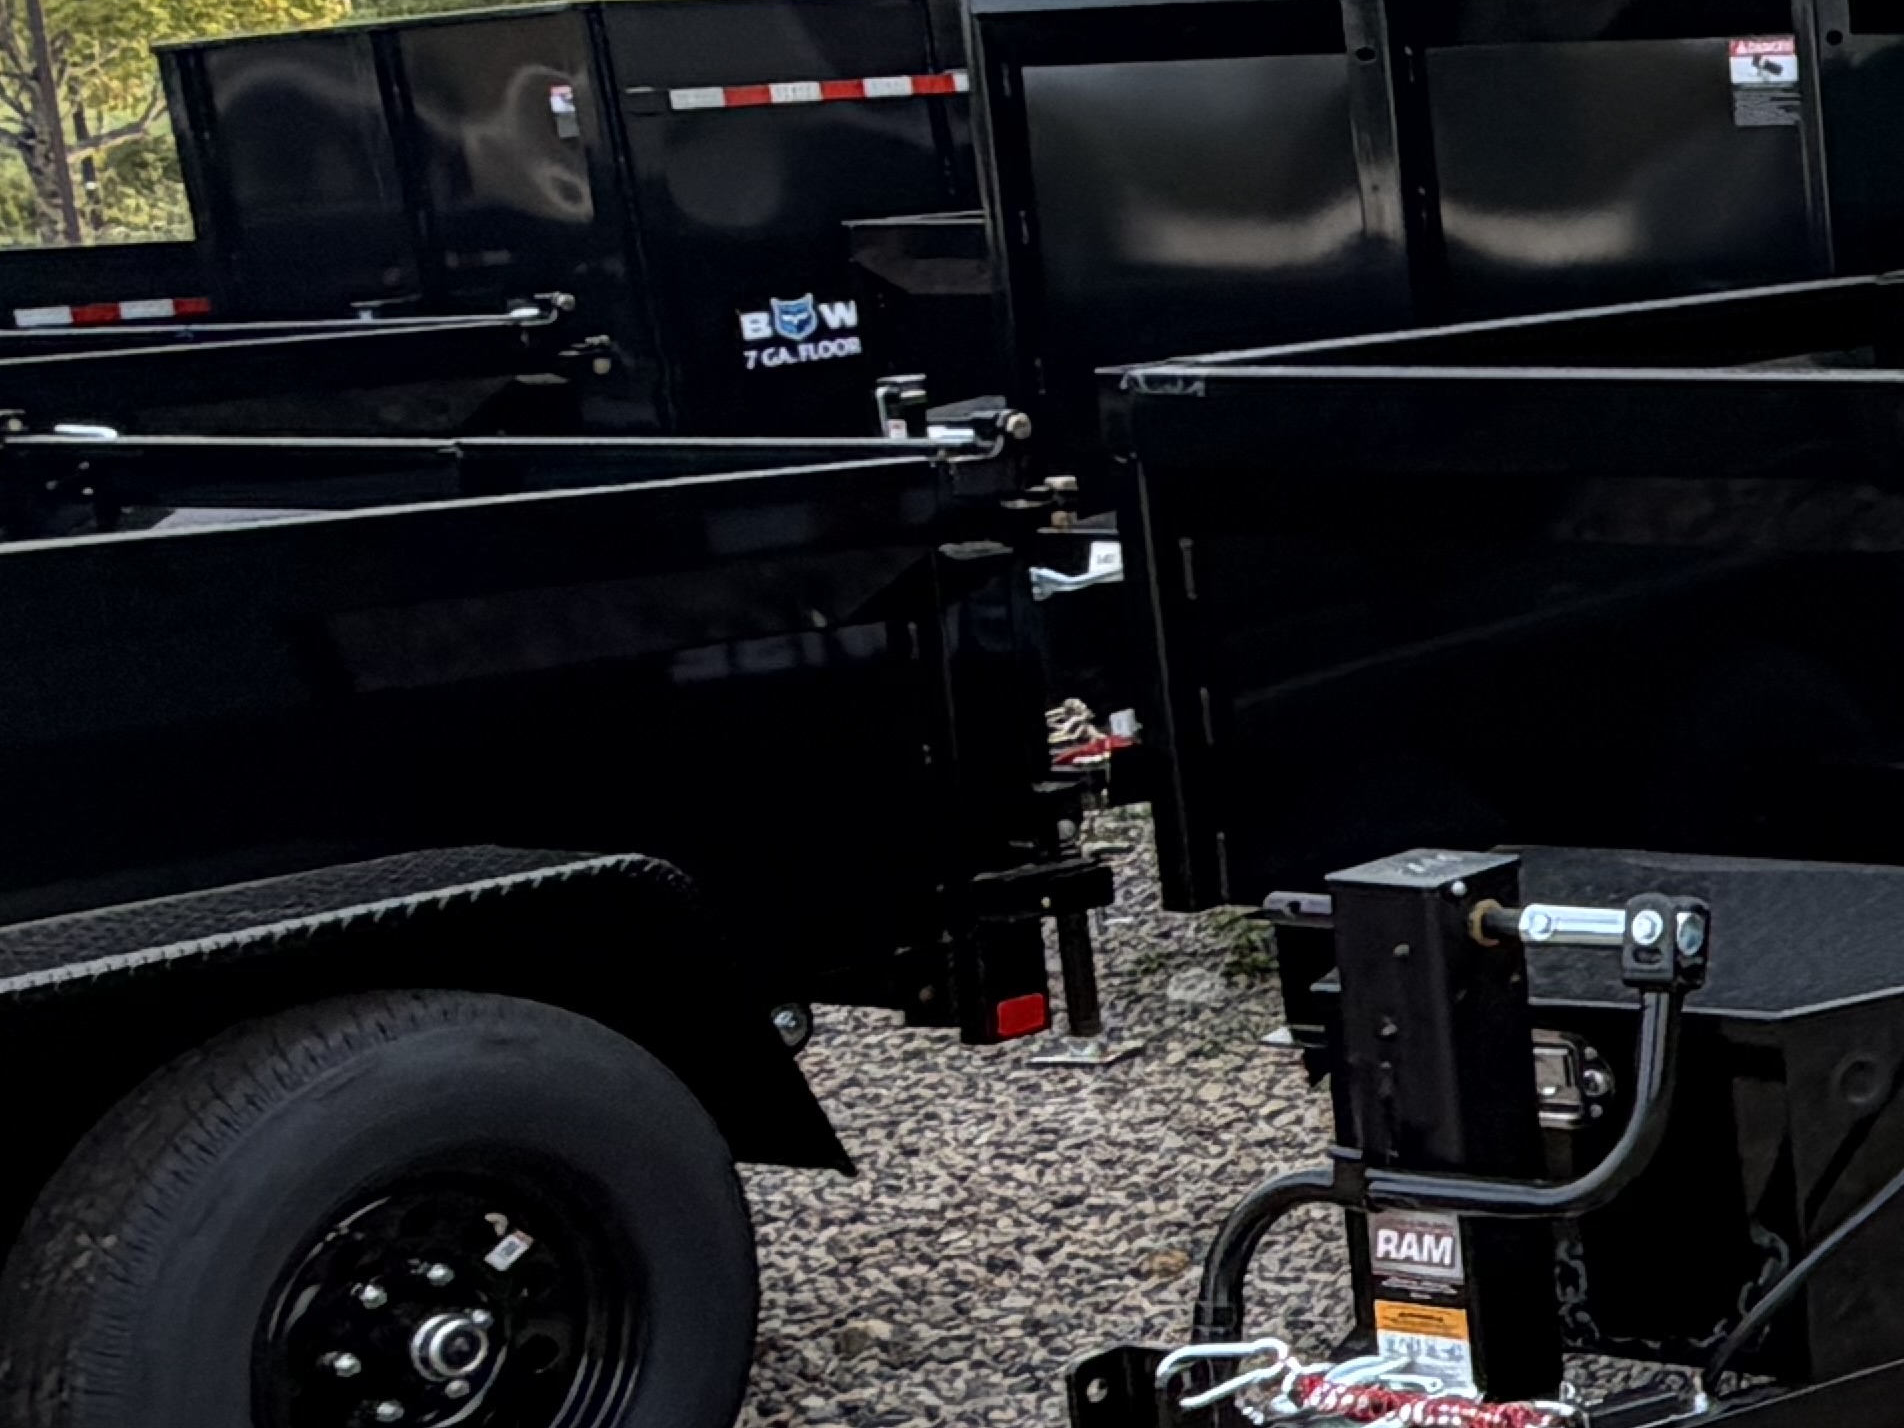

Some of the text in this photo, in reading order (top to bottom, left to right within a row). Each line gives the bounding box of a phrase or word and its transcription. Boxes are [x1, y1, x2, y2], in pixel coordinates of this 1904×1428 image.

[743, 349, 758, 370] 7
[799, 336, 862, 362] FLOOR
[1376, 1228, 1454, 1266] RAM
